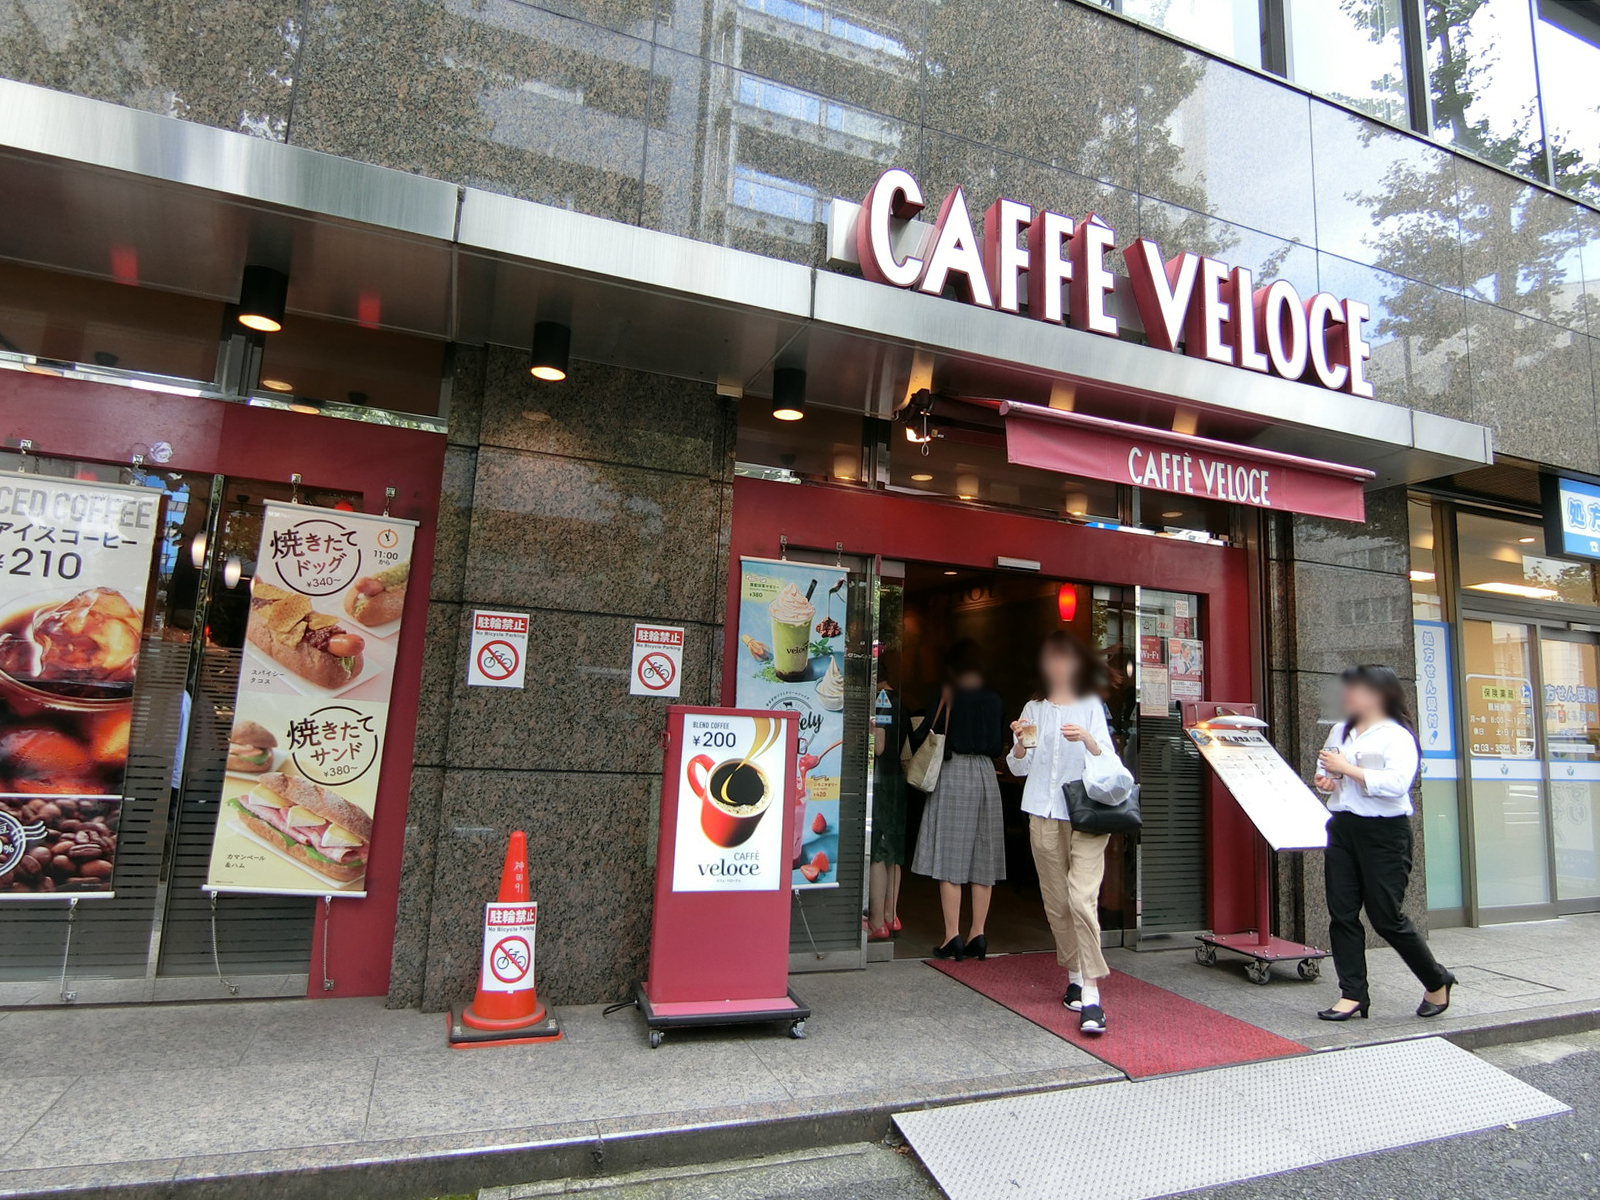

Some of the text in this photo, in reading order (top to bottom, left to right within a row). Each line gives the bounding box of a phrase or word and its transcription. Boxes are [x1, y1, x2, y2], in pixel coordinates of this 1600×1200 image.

[867, 167, 1376, 398] CAFFÈ VELOCE
[1128, 446, 1271, 506] CAFFÈ VELOCE
[53, 492, 154, 529] COFFEE
[0, 521, 138, 549] アイスコーヒー
[270, 529, 358, 559] 焼きたて
[374, 549, 399, 561] 11:00
[296, 552, 347, 577] ドッグ
[476, 616, 526, 631] 駐輪禁止
[638, 630, 681, 643] 駐輪禁止
[250, 677, 271, 685] タコス
[251, 669, 285, 677] スパイシー
[1422, 630, 1439, 729] 処方せん受付
[286, 715, 374, 750] 焼きたて
[692, 731, 737, 747] ¥200
[310, 742, 363, 767] サンド
[226, 853, 266, 861] カマンベール
[734, 850, 760, 861] CAFFÈ
[697, 859, 761, 876] veloce
[489, 909, 535, 924] 駐輪禁止
